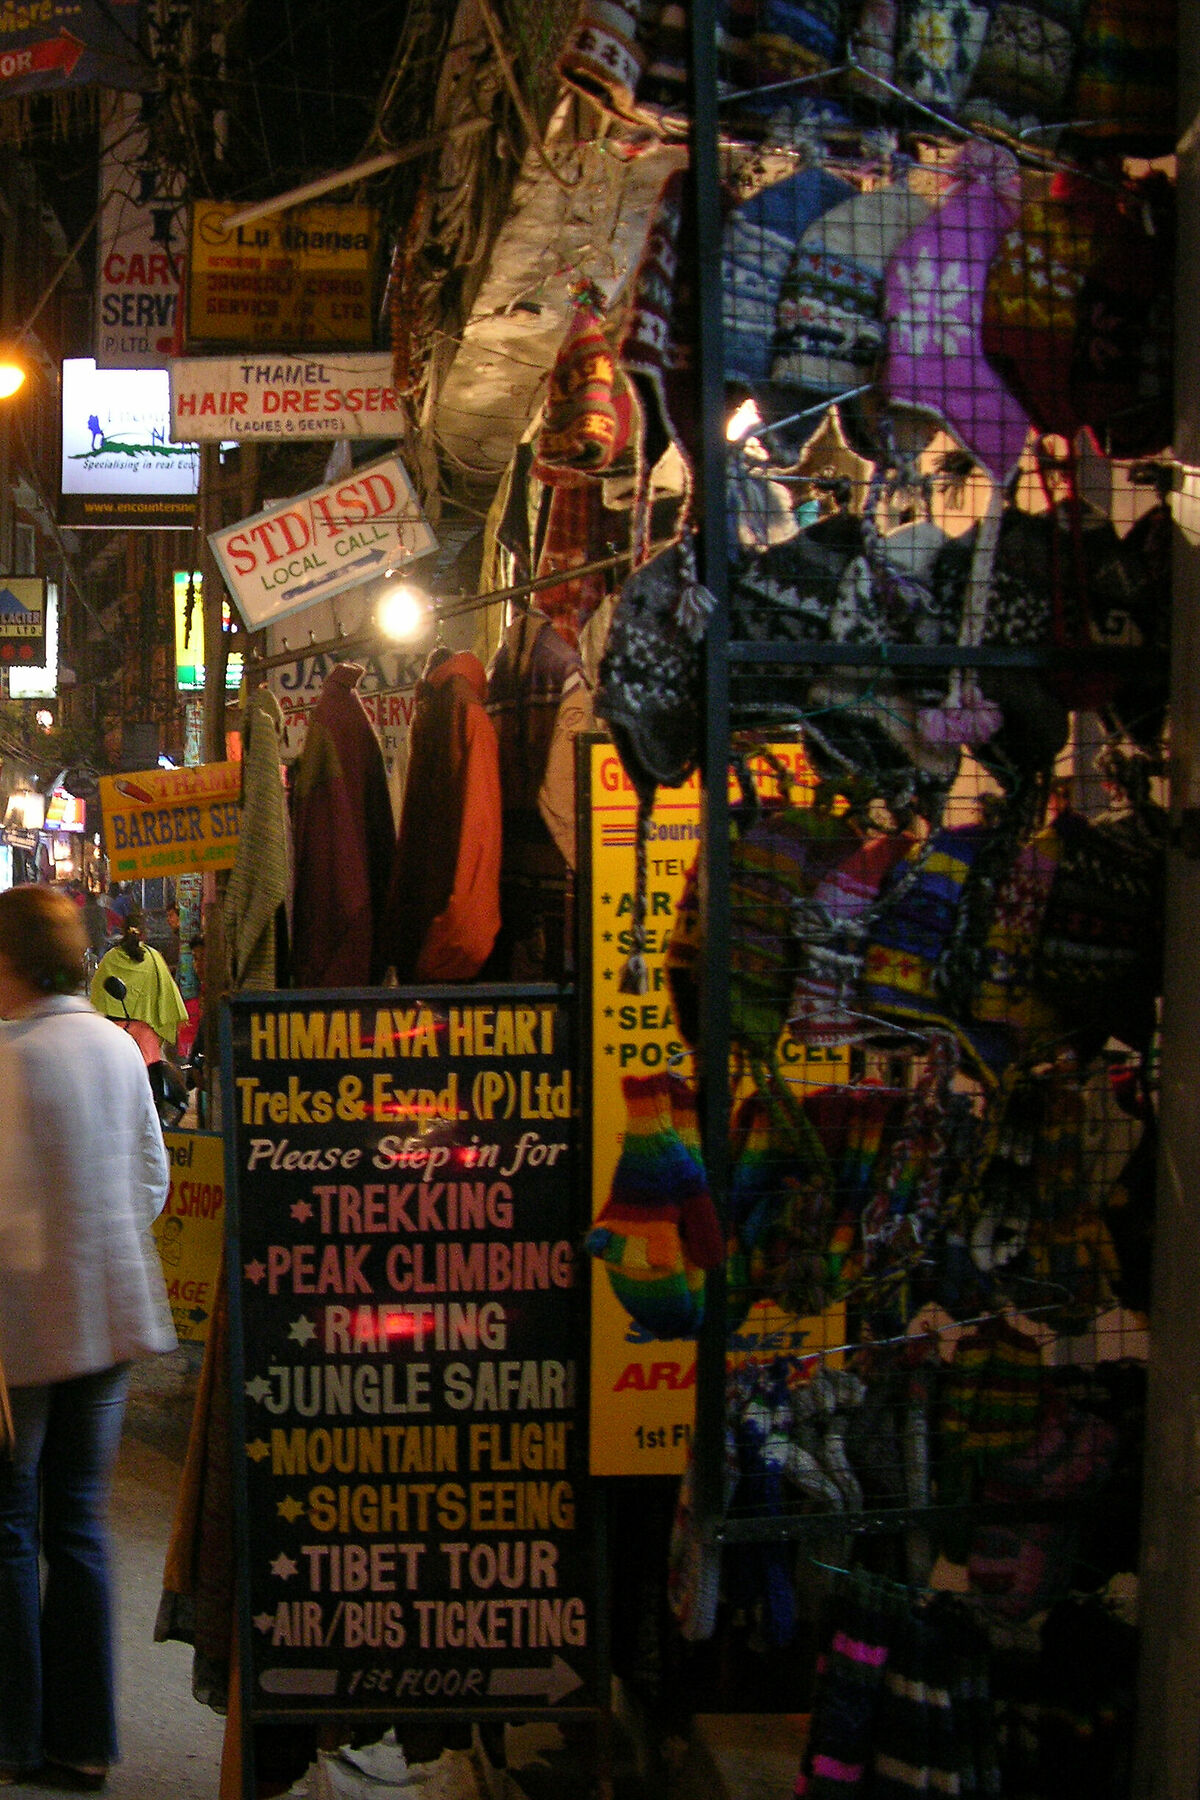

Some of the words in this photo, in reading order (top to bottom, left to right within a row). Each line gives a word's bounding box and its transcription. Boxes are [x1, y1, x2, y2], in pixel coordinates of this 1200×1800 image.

[240, 364, 331, 385] THAMEL
[177, 391, 248, 417] HAIR
[262, 387, 399, 415] DRESSER
[83, 459, 140, 473] Specialising
[143, 460, 153, 470] in
[156, 459, 175, 469] real
[226, 474, 397, 577] STD/ISD
[260, 553, 328, 592] LOCAL
[334, 525, 390, 557] CALL
[112, 806, 205, 850] BARBER
[616, 891, 672, 917] AR
[250, 1008, 440, 1060] HIMALAYA
[450, 1004, 557, 1057] HEART
[247, 1138, 361, 1172] Please
[372, 1135, 451, 1183] Step
[463, 1134, 499, 1169] in
[499, 1131, 569, 1178] for
[176, 1181, 224, 1220] SHOP
[312, 1181, 514, 1235] TREKKING
[267, 1244, 375, 1295] PEAK
[385, 1240, 574, 1293] CLIMBING
[324, 1302, 508, 1354] RAFTING
[263, 1363, 433, 1416] JUNGLE
[271, 1424, 459, 1476] MOUNTAIN
[469, 1421, 575, 1472] FLIGH
[635, 1425, 666, 1449] 1st
[308, 1481, 575, 1533] SIGHTSEEING
[301, 1542, 428, 1593] TIBET
[439, 1540, 559, 1591] TOUR
[271, 1600, 407, 1648] AIR/BUS
[413, 1597, 587, 1649] TICKETING
[397, 1668, 486, 1697] FLOOR
